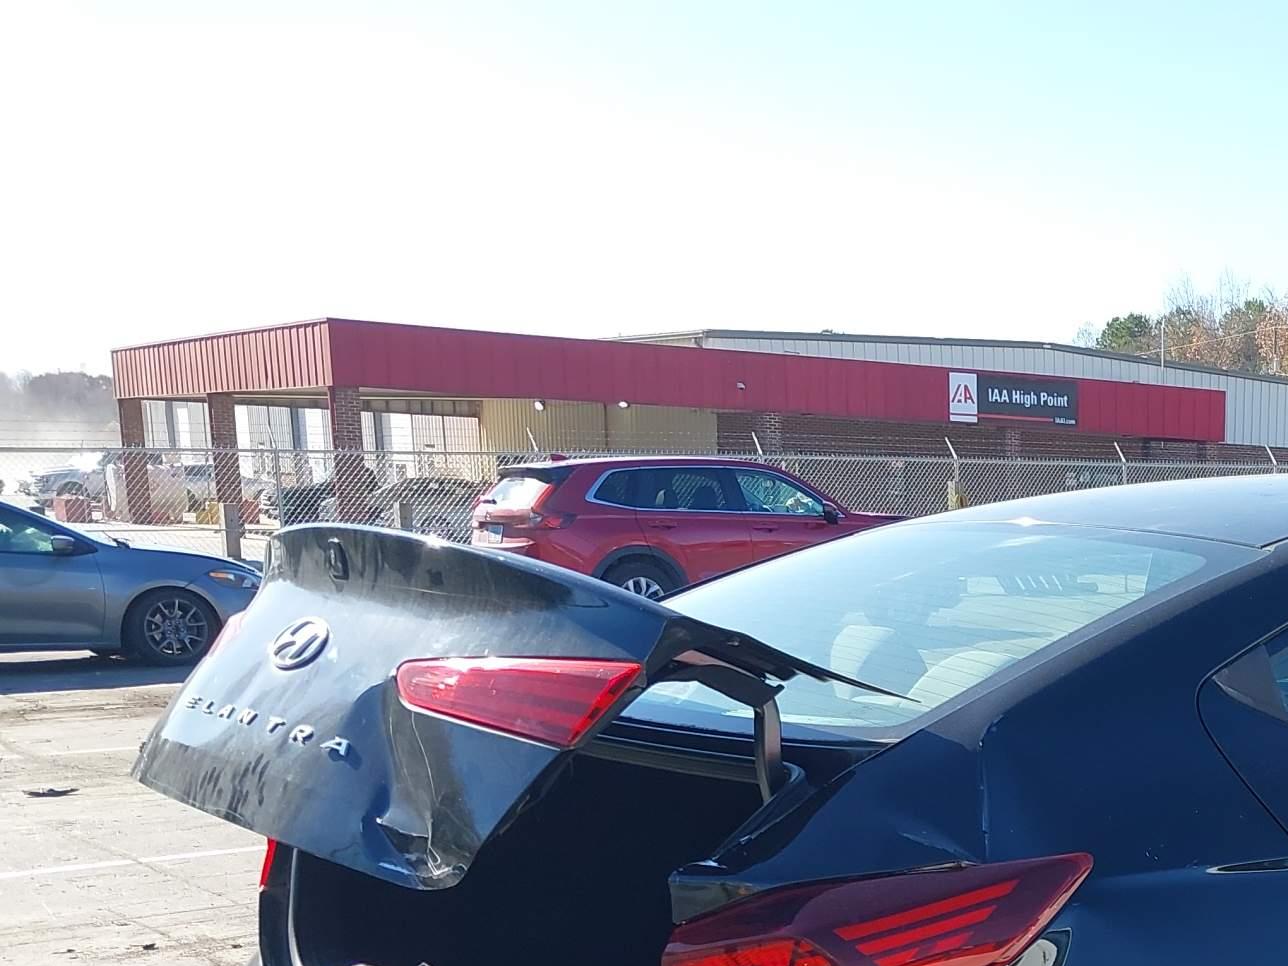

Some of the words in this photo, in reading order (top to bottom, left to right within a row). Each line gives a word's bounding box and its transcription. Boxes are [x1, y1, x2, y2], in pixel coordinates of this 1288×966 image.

[988, 387, 1010, 403] IAA
[1012, 389, 1038, 408] High
[1040, 392, 1069, 408] Point
[185, 696, 351, 757] ELANTRA
